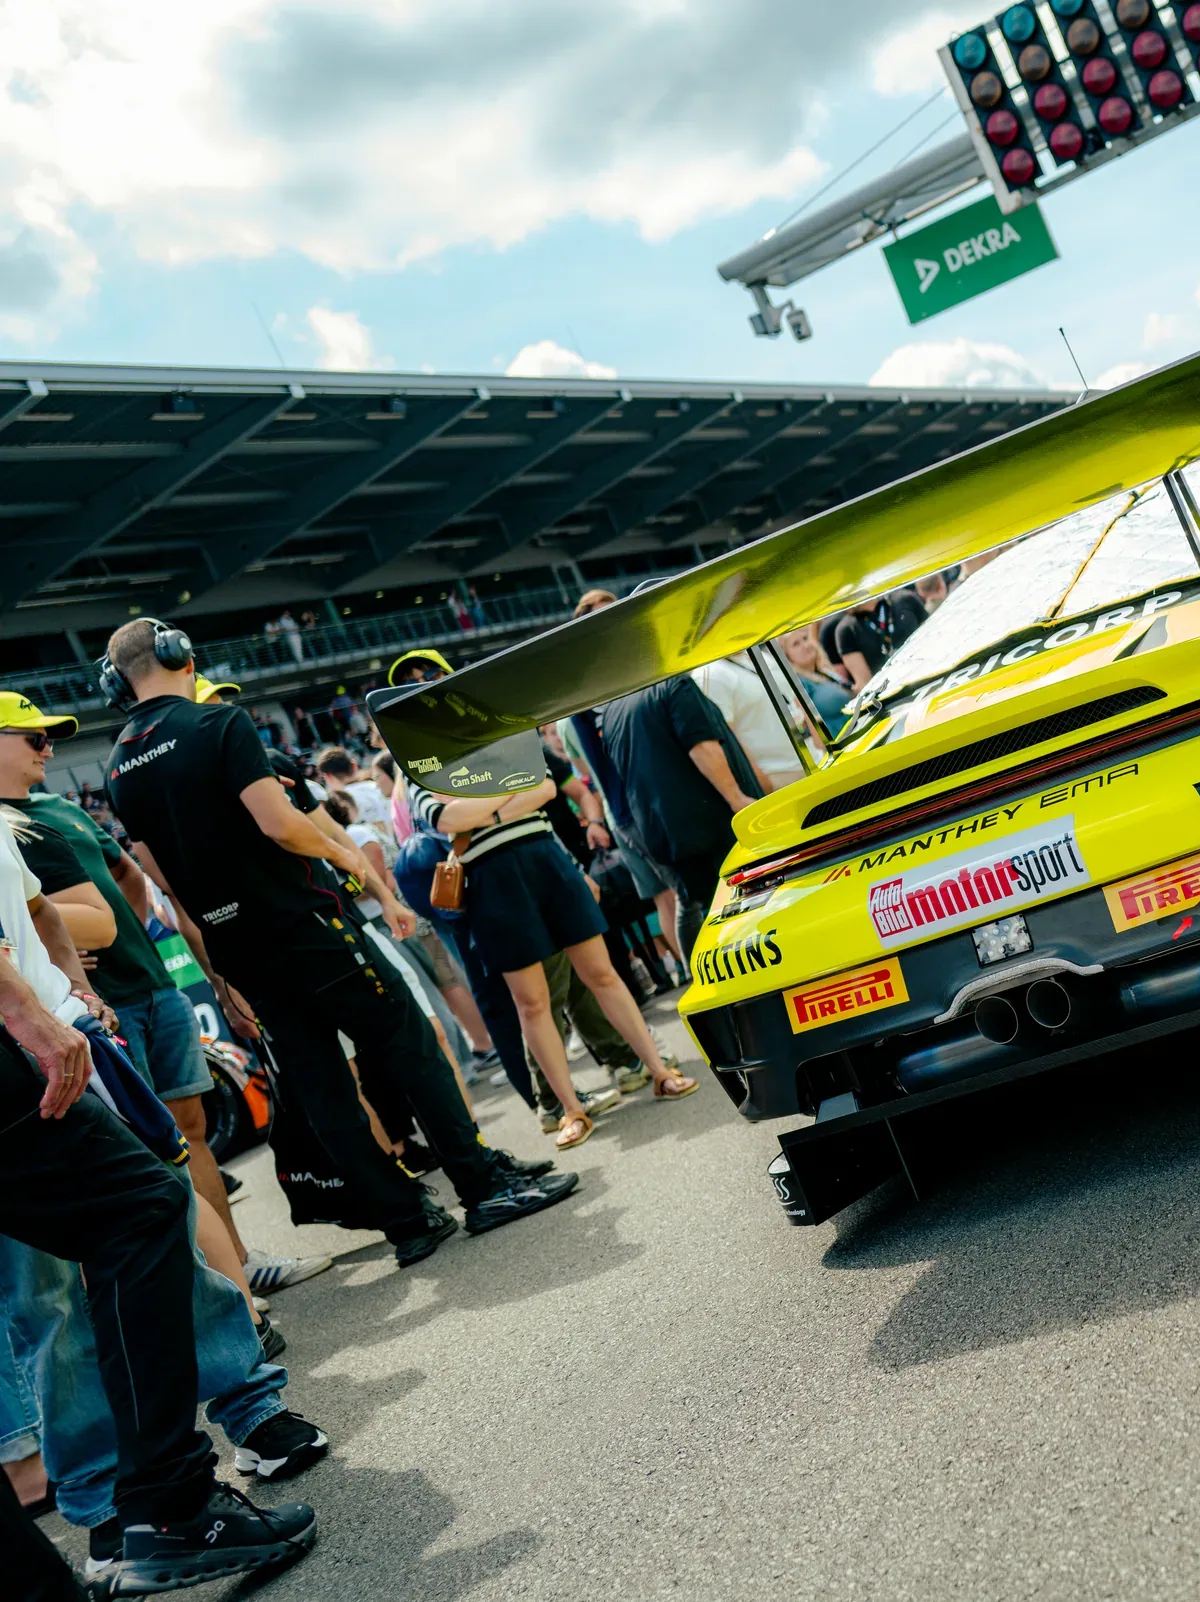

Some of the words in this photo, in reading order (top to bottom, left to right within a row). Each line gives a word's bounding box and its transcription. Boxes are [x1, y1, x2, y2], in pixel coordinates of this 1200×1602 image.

[943, 222, 1021, 273] DEKRA
[912, 591, 1182, 702] TRICORP
[119, 739, 177, 774] MANTHEY
[451, 775, 470, 788] Cam
[469, 771, 492, 785] Shaft
[858, 803, 1024, 873] MANTHEY
[1040, 763, 1139, 810] EMA
[202, 902, 239, 922] TRICORP
[870, 881, 903, 913] Auto
[877, 905, 909, 936] Bild
[696, 929, 783, 986] VELTINS
[793, 969, 894, 1024] PIRELLI
